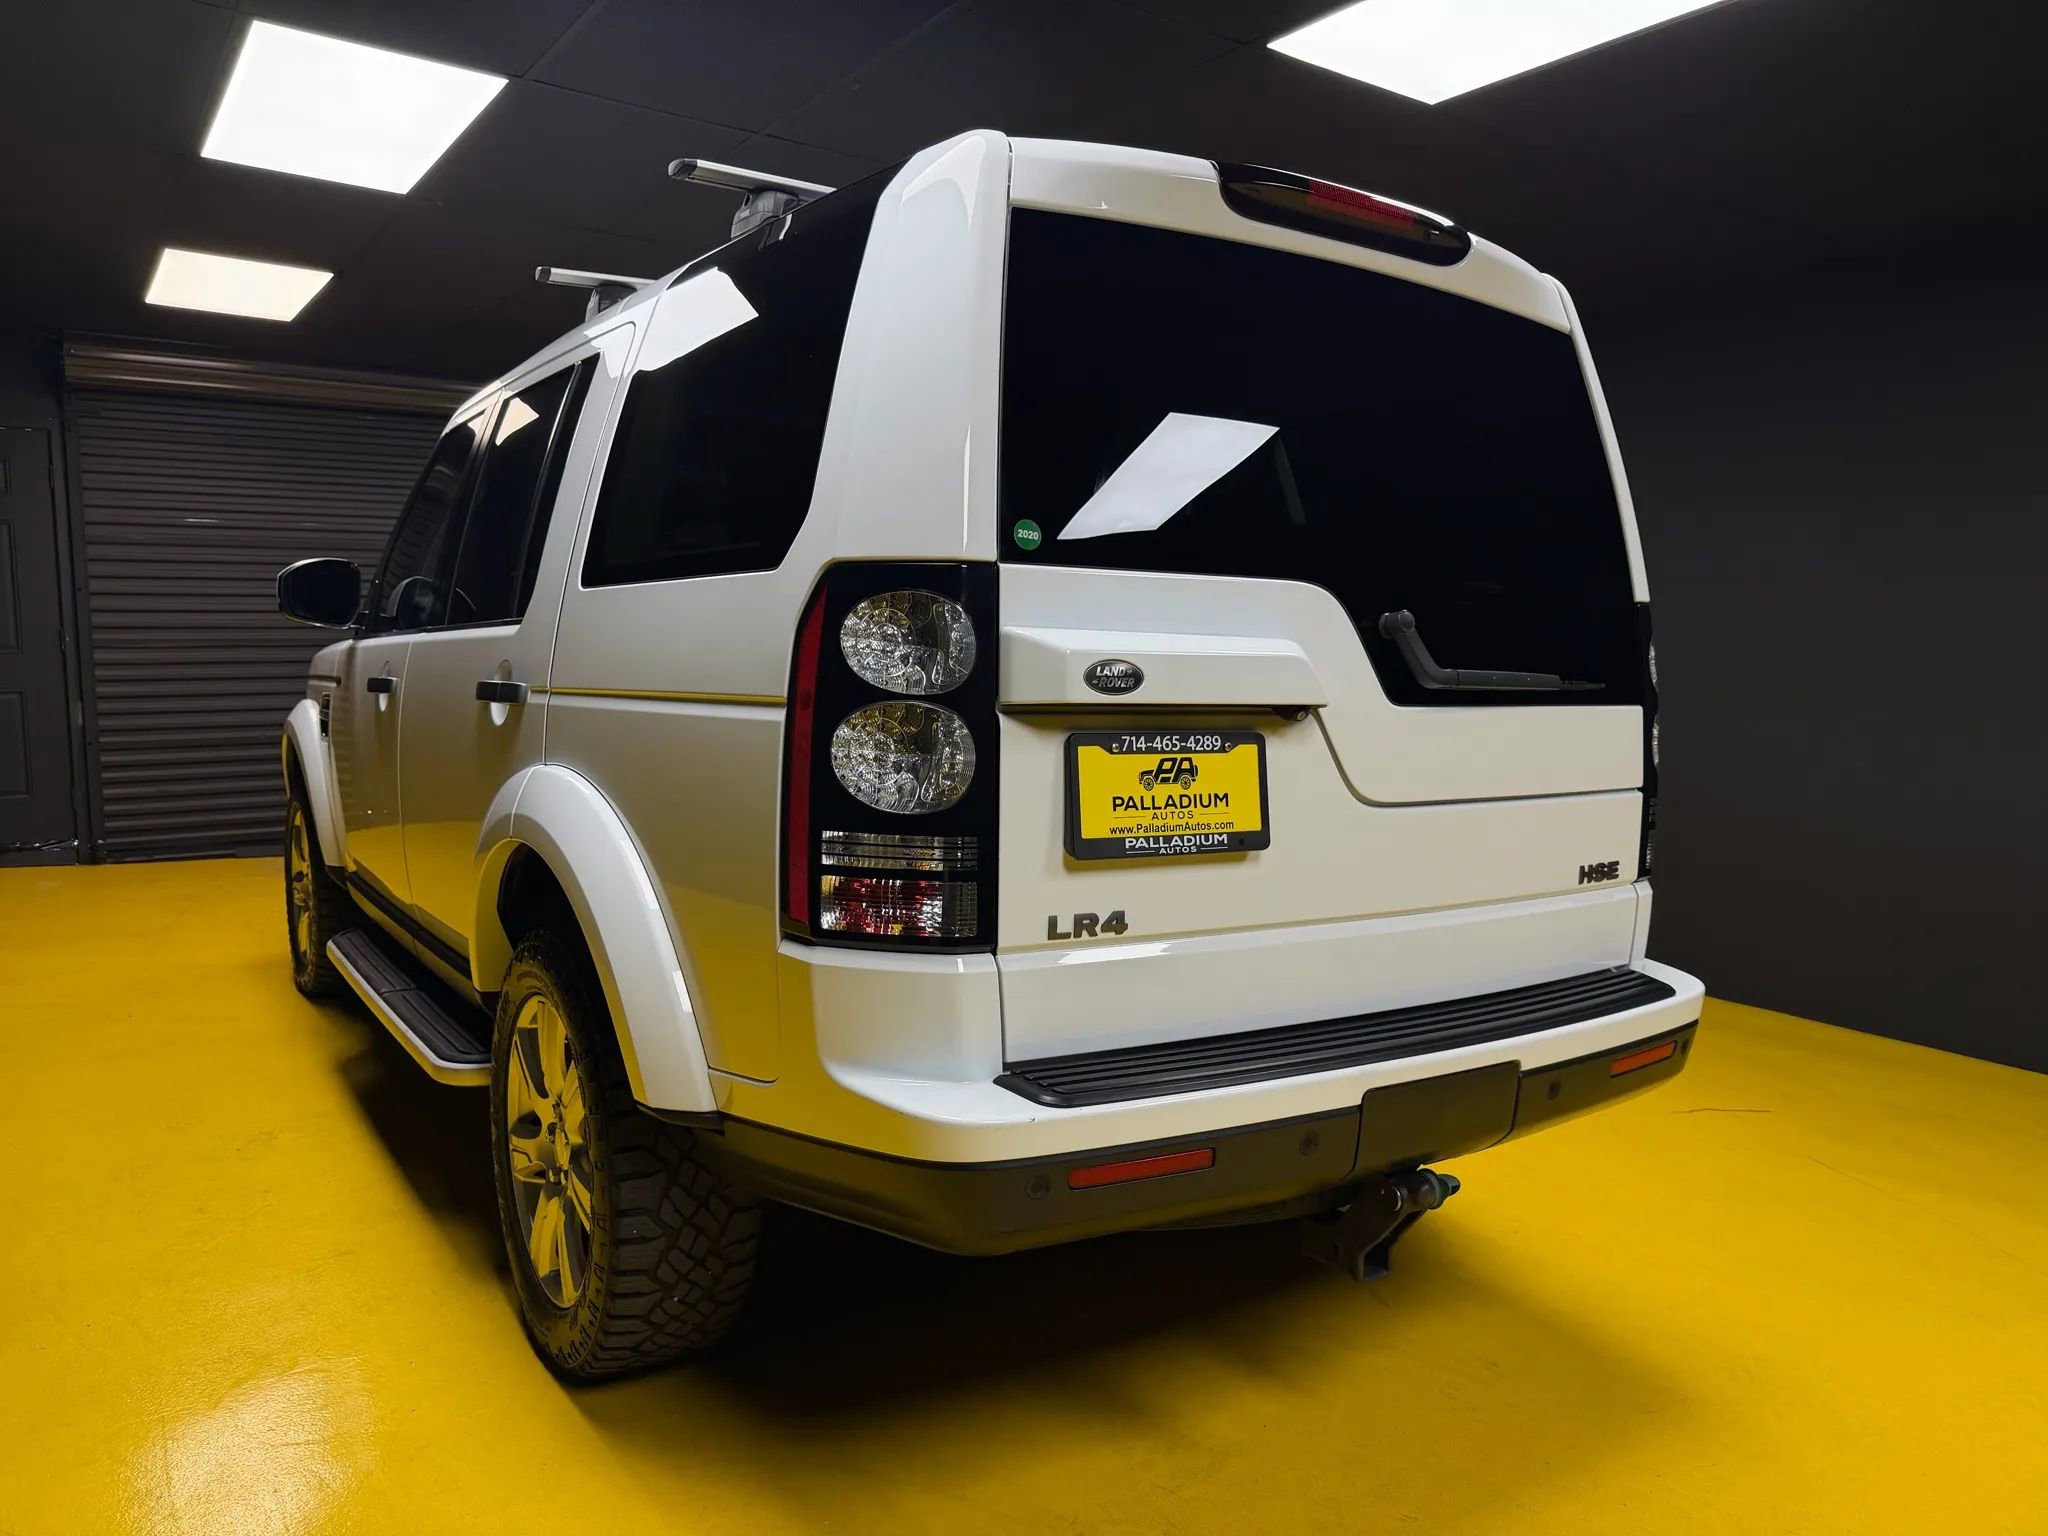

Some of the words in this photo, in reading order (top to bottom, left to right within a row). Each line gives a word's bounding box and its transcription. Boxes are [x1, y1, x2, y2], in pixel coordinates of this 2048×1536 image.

[1017, 529, 1039, 540] 2020
[1096, 666, 1126, 676] LAND
[1099, 677, 1135, 688] ROVER
[1121, 735, 1221, 752] 714-465-4289
[1112, 793, 1229, 811] PALLADIUM
[1151, 811, 1194, 820] AUTOS
[1109, 821, 1234, 834] www.PalladiumAutos.com
[1125, 834, 1228, 848] PALLADIUM
[1158, 846, 1197, 855] AUTOS
[1578, 860, 1620, 886] HSE
[1047, 910, 1129, 941] LR4
